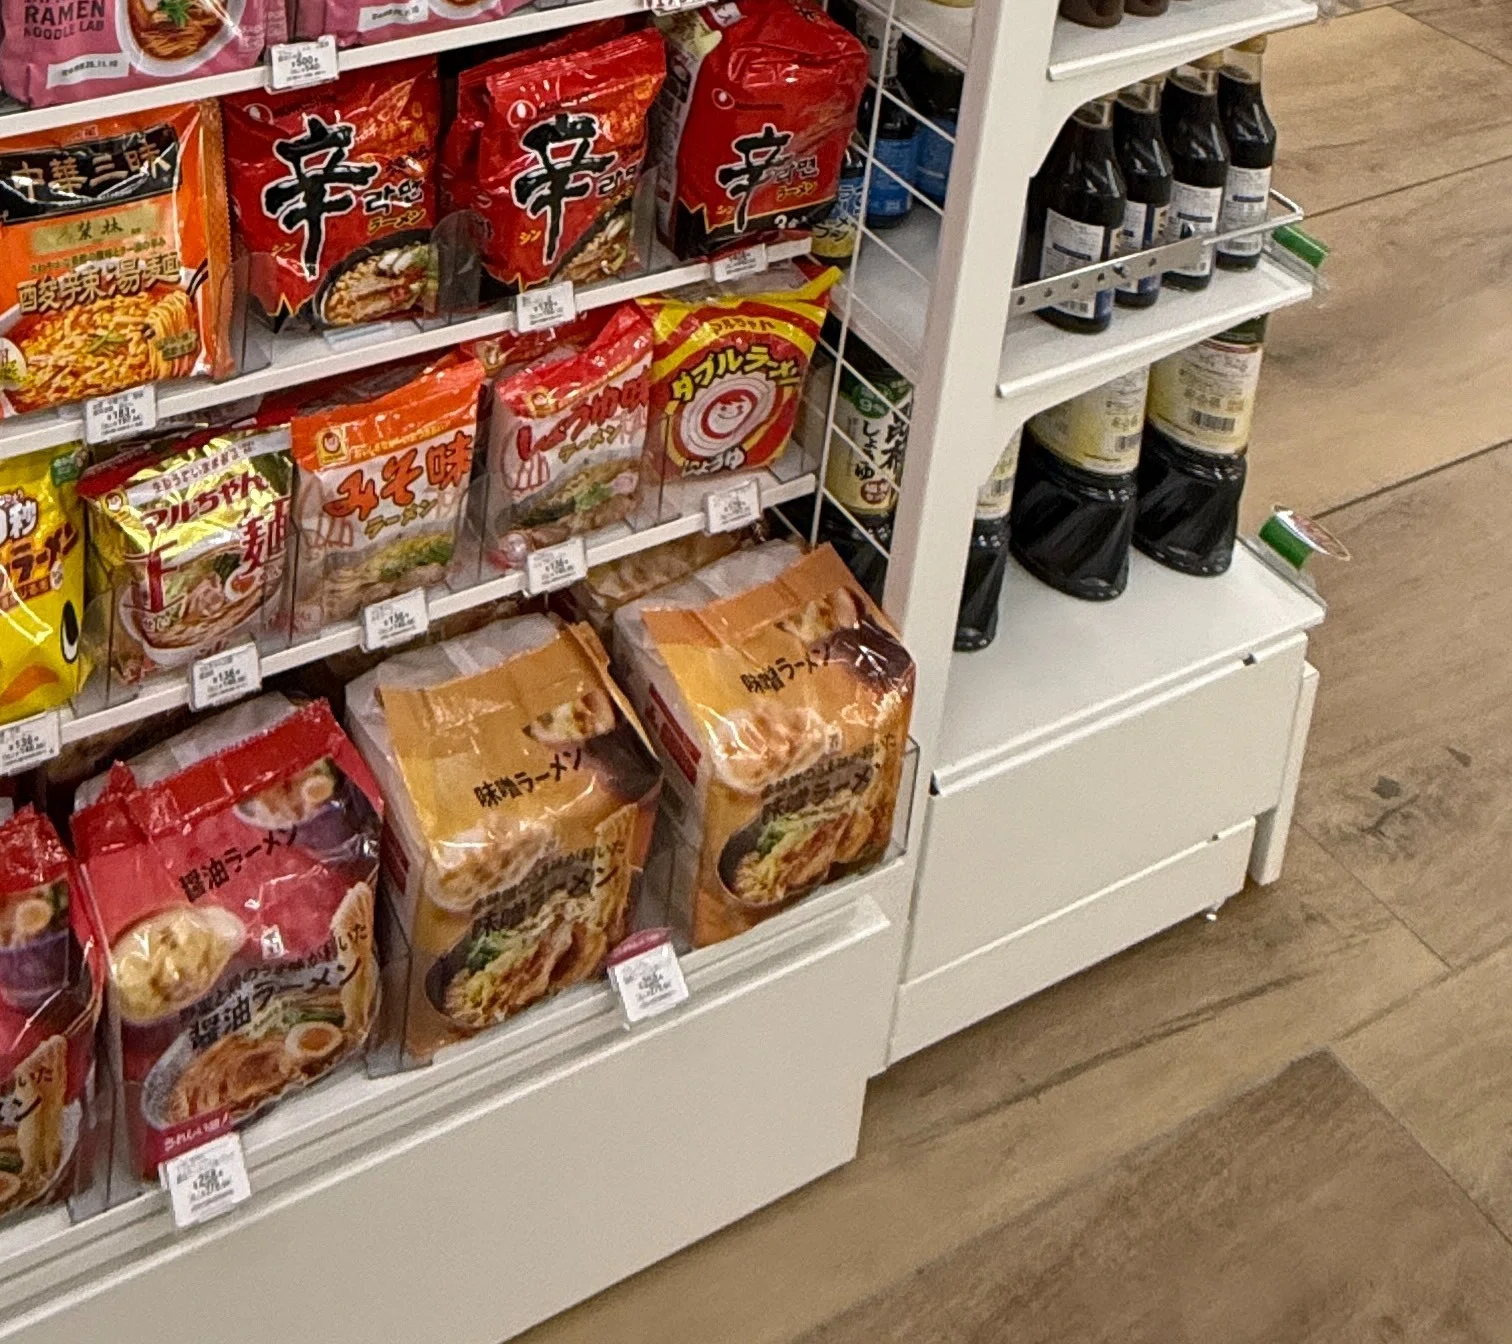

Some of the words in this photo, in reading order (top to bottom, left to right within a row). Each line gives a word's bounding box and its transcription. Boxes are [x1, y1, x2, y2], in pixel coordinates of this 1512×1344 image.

[22, 23, 76, 41] NOODLE
[262, 114, 380, 282] 辛
[511, 112, 619, 266] 辛
[716, 123, 794, 234] 辛
[323, 429, 475, 520] みそ味
[740, 648, 834, 698] 味噌ラーメン
[473, 745, 586, 811] 味噌ラーメン
[178, 824, 302, 900] 醤油ラーメン
[189, 958, 364, 1054] 醤油ラーメン
